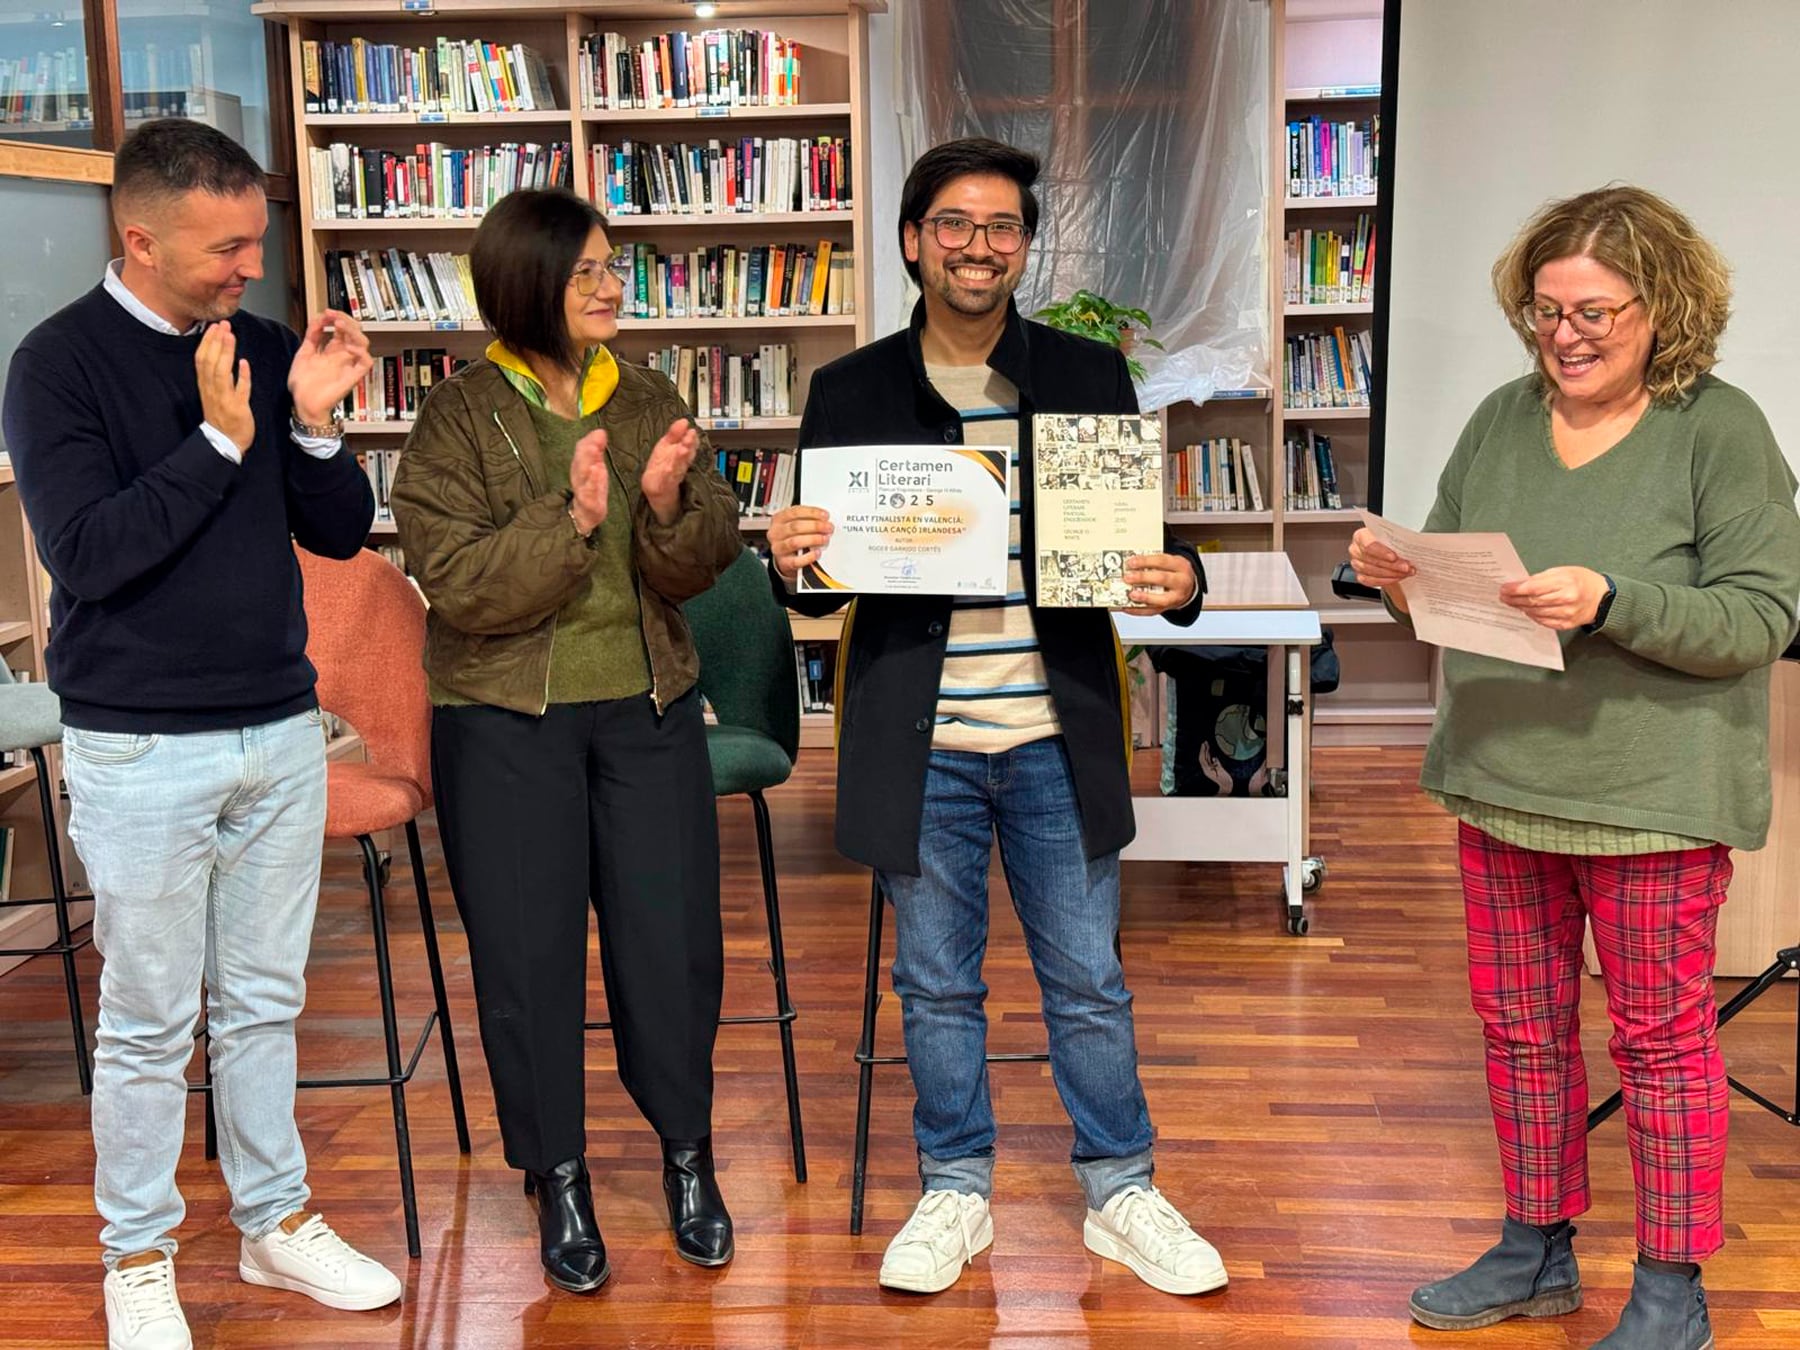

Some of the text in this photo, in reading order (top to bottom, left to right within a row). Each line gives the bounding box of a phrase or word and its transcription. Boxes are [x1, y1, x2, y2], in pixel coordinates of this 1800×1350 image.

[879, 459, 953, 472] Certamen
[848, 471, 869, 487] XI
[878, 473, 931, 486] Literari
[871, 515, 911, 523] FINALISTA
